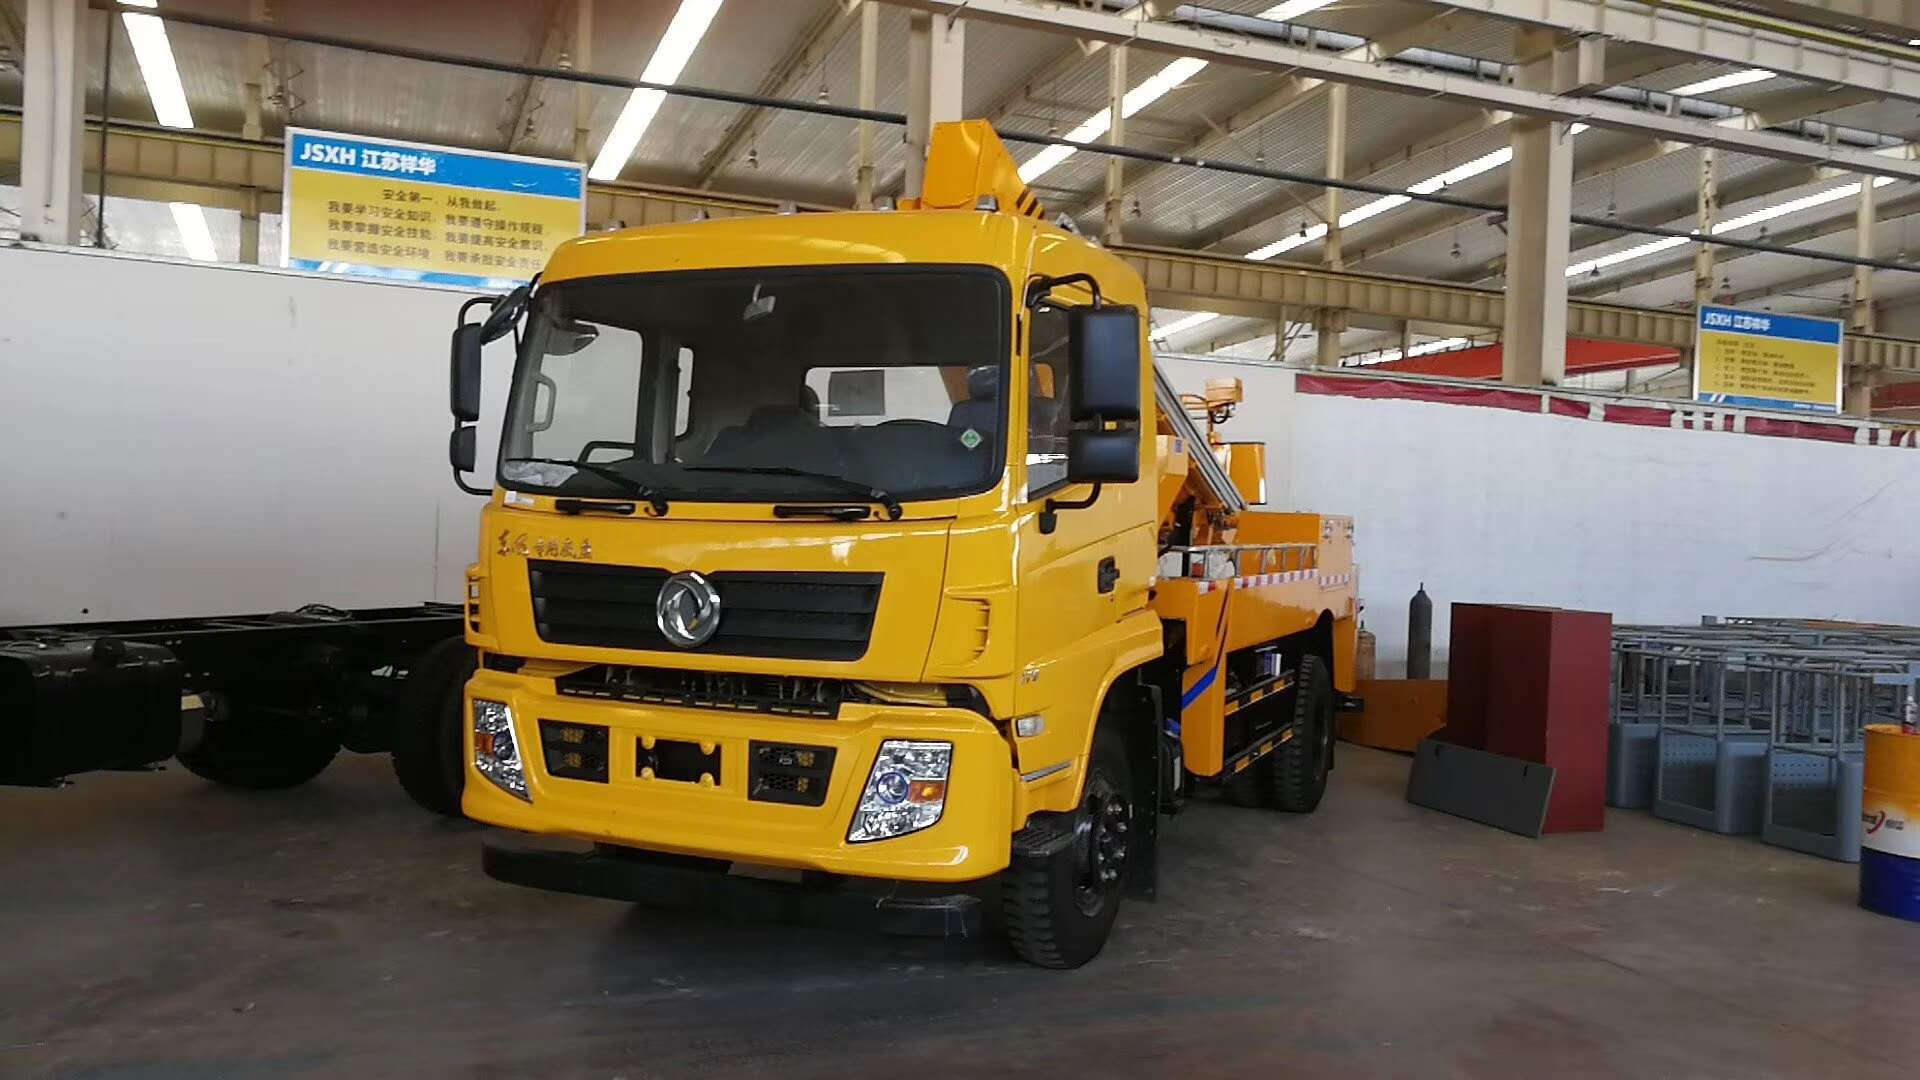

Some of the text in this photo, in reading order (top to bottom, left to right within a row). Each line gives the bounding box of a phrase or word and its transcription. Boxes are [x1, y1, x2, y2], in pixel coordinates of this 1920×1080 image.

[300, 142, 437, 176] JSXH 江苏祥华
